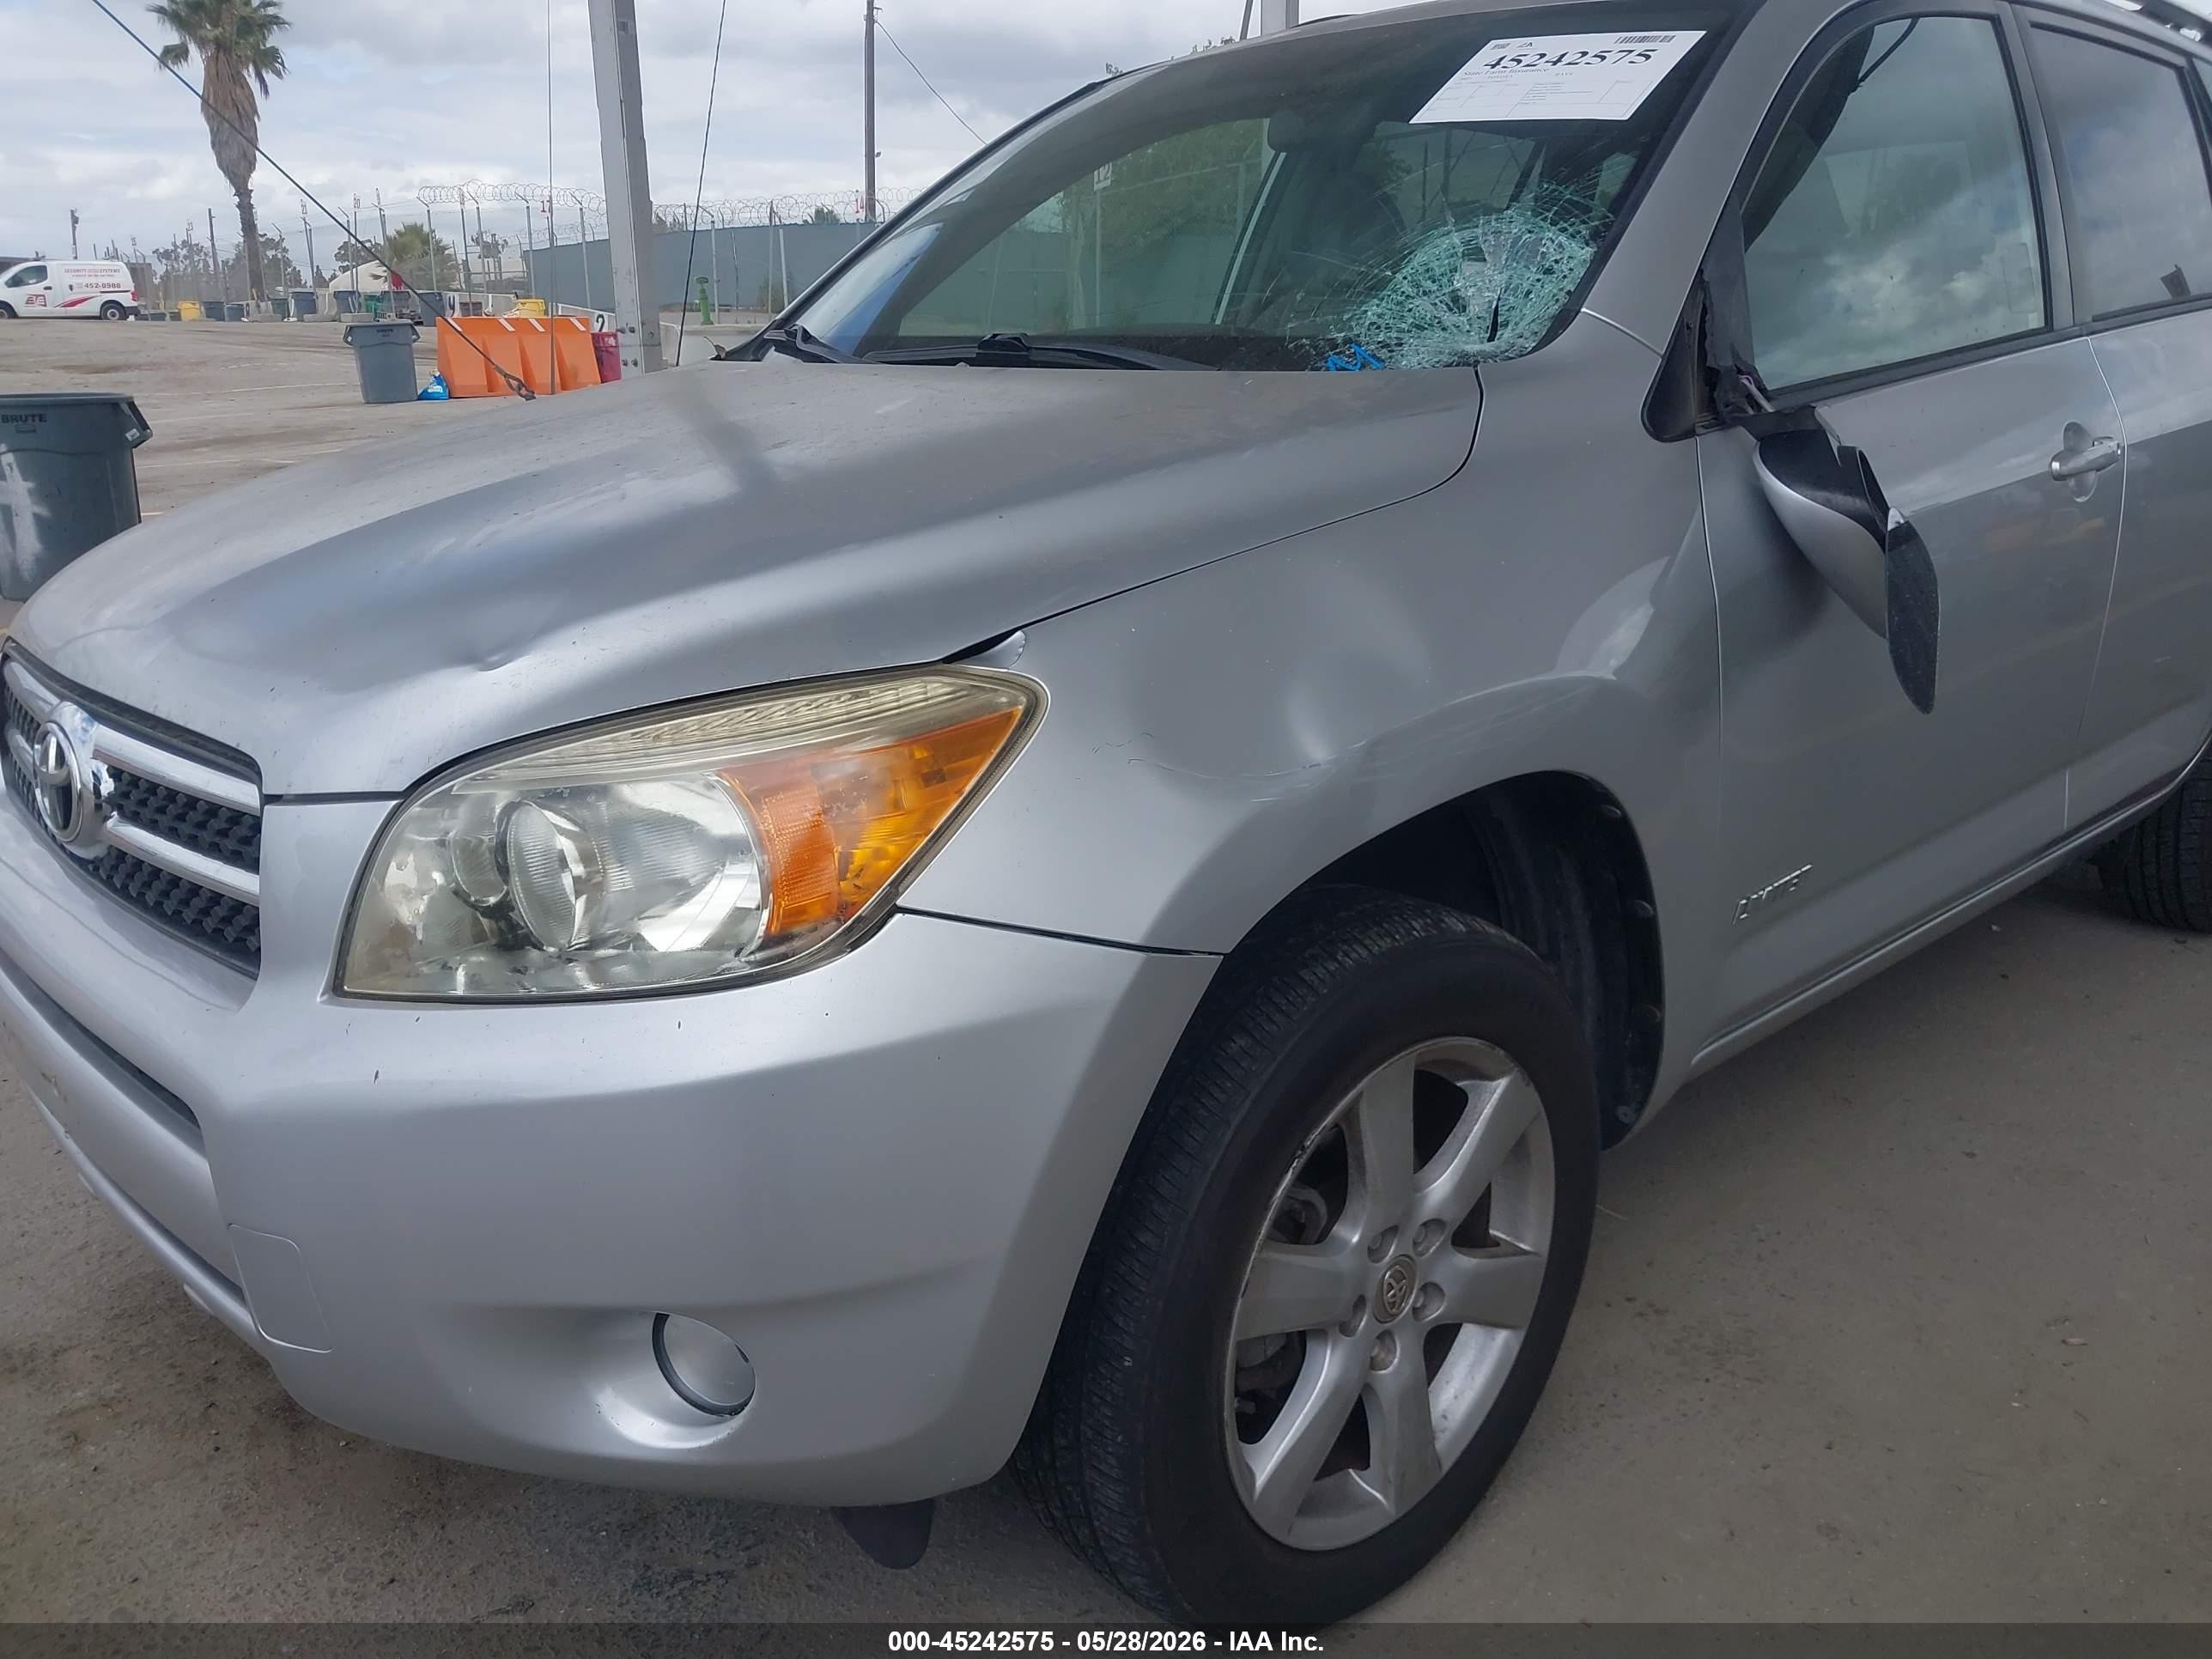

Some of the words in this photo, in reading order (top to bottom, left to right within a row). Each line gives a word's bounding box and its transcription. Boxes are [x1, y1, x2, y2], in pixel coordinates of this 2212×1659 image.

[1483, 48, 1659, 70] 45242575
[854, 195, 865, 213] 14
[1, 413, 47, 424] BRUTE
